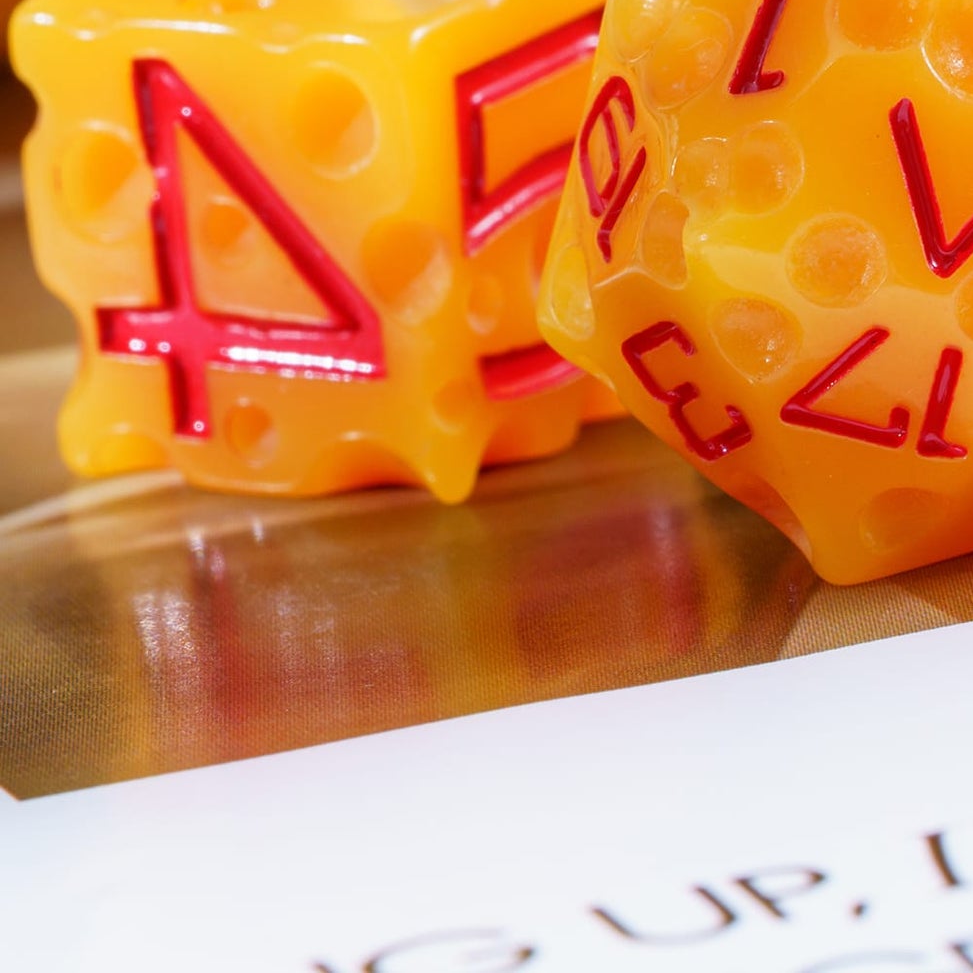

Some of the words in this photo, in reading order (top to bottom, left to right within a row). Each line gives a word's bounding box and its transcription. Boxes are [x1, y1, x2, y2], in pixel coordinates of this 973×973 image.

[95, 57, 388, 441] 4
[621, 320, 753, 461] 3
[586, 862, 870, 947] UP,
